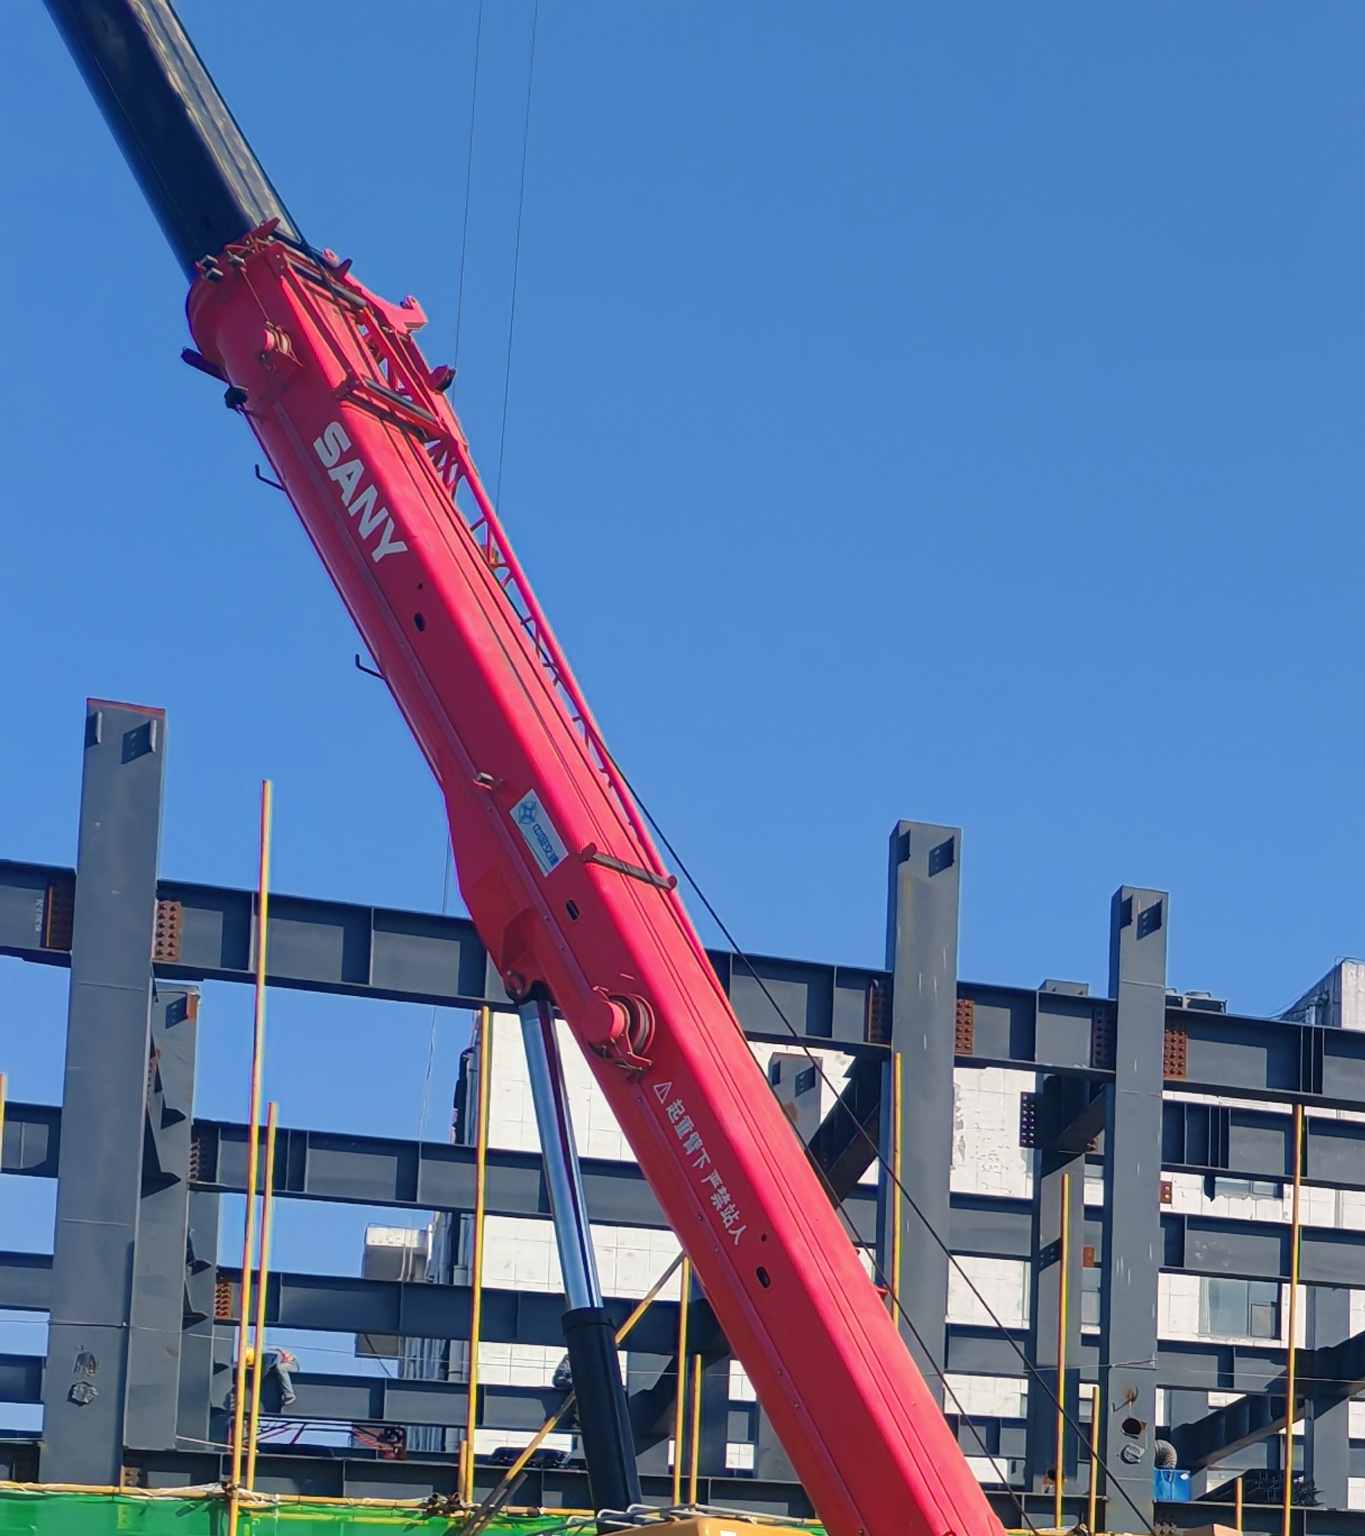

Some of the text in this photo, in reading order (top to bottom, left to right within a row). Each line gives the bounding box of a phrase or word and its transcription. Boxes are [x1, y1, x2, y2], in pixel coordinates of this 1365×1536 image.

[313, 421, 408, 563] SANY
[701, 1168, 749, 1246] 严禁站人
